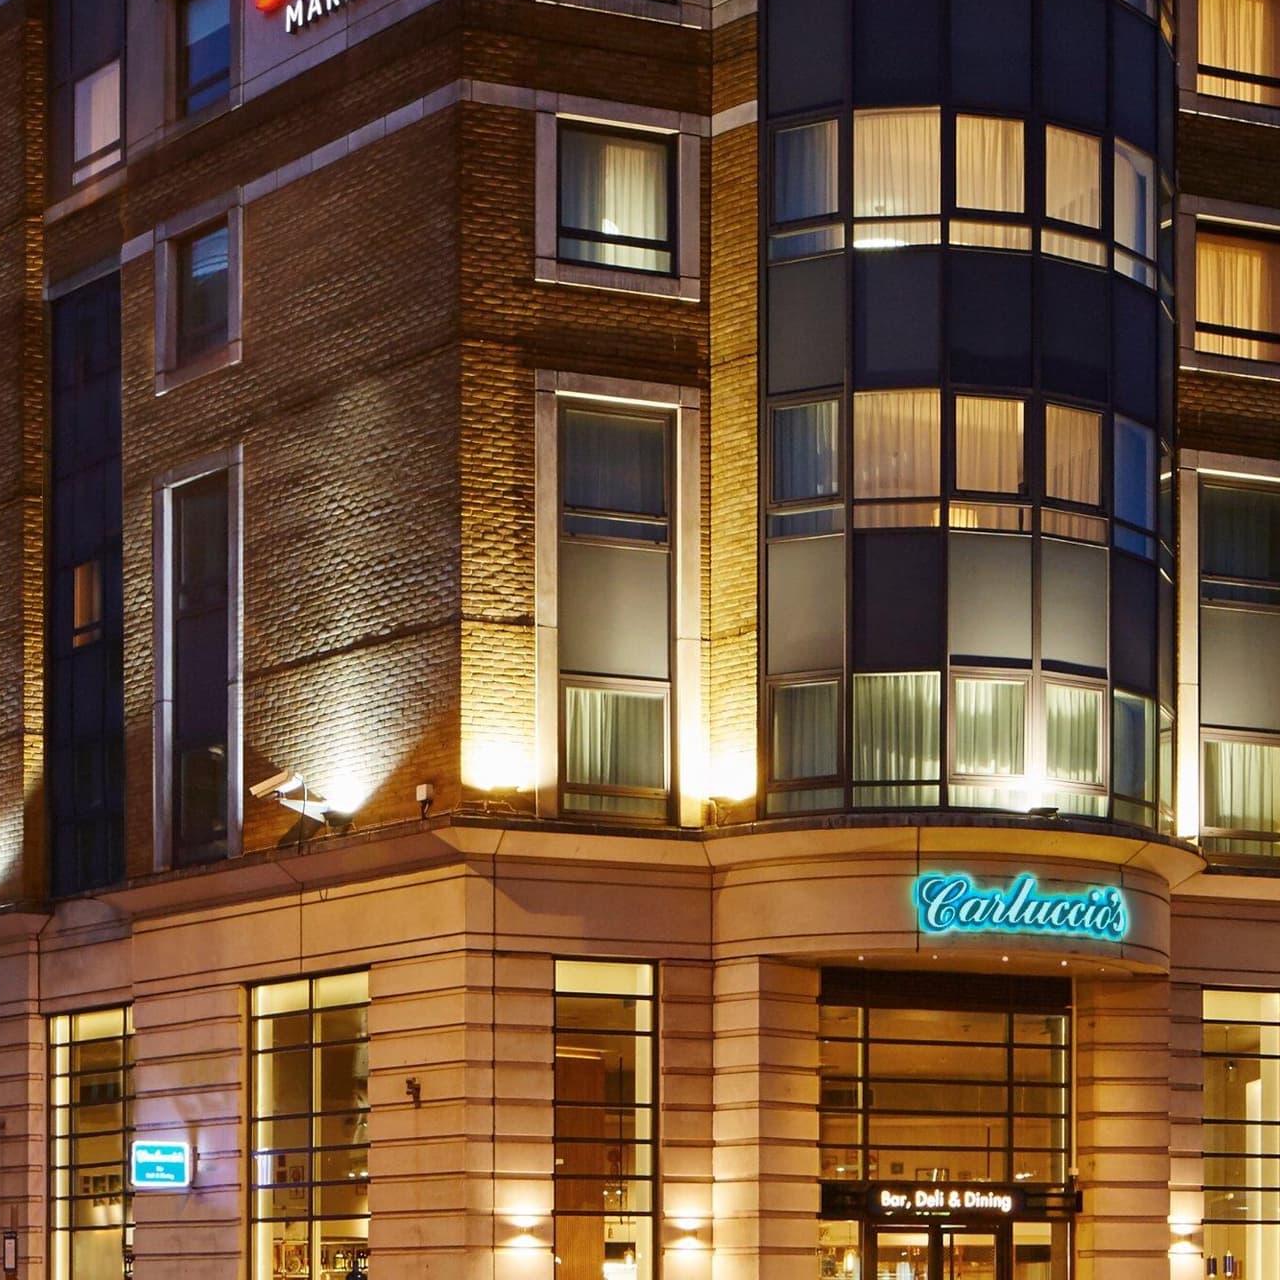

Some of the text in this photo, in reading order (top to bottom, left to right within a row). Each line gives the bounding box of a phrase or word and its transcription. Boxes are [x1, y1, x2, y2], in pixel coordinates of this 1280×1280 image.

[921, 877, 1125, 933] Carluccio's
[880, 1189, 1012, 1213] Bar, Deli & Dining
